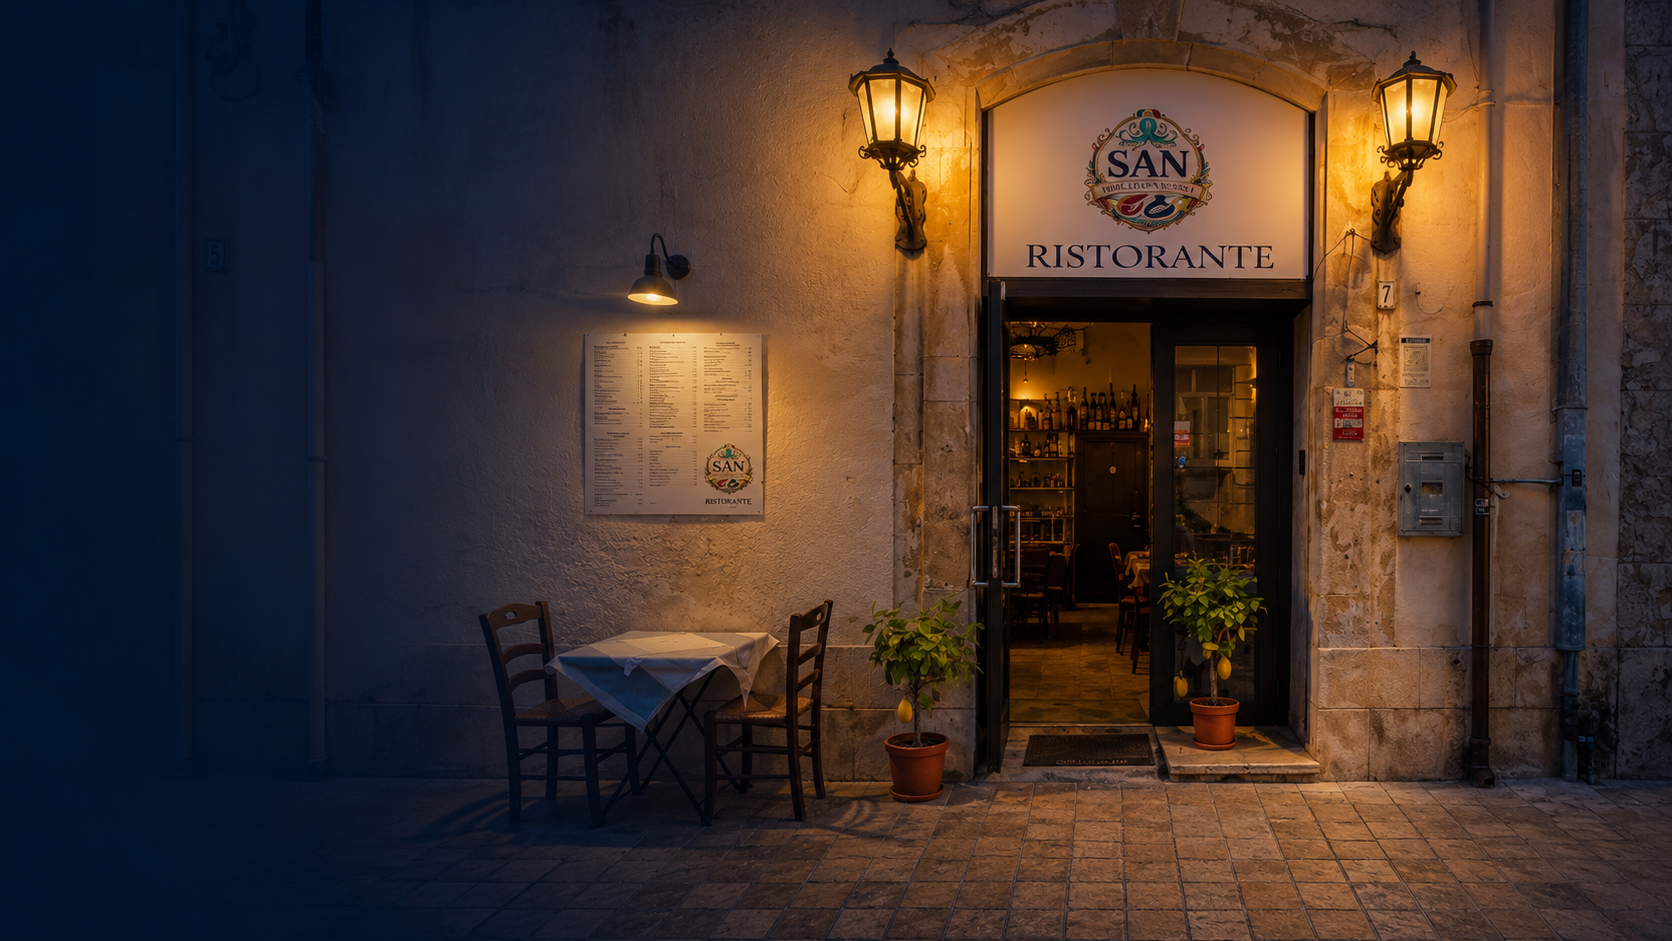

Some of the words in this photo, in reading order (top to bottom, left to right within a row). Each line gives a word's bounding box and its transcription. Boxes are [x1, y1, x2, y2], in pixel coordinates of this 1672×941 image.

[1107, 149, 1190, 178] SAN
[210, 245, 220, 266] 5
[1027, 244, 1274, 269] RISTORANTE
[1382, 285, 1391, 303] 7
[712, 460, 745, 473] SAN
